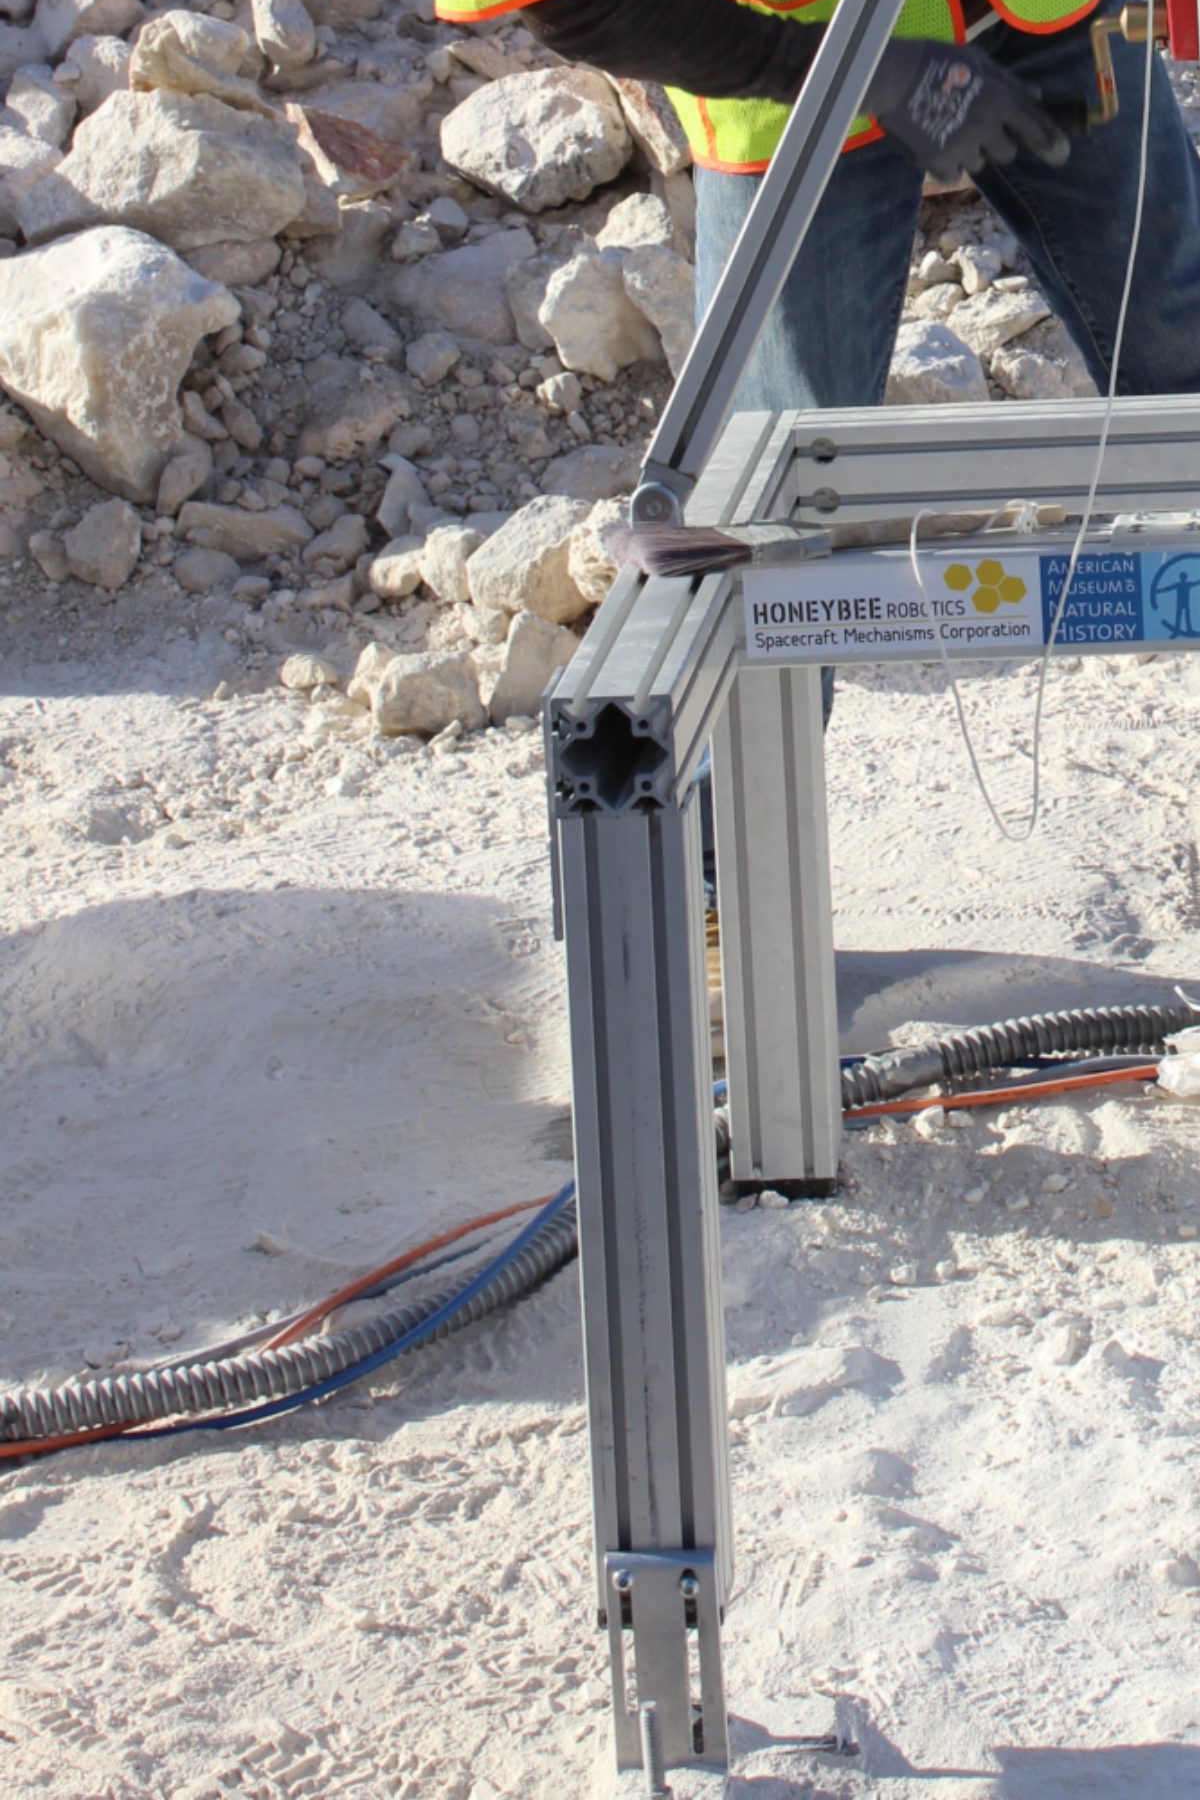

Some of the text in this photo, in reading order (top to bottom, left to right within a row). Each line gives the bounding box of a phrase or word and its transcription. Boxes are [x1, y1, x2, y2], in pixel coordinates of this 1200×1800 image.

[1048, 579, 1122, 595] MUSEUM
[753, 597, 882, 625] HONEYBEE
[1049, 600, 1136, 618] NATURAL
[755, 621, 1031, 650] Spacecraft Mechanisms Corporation
[1051, 622, 1137, 641] HISTORY
